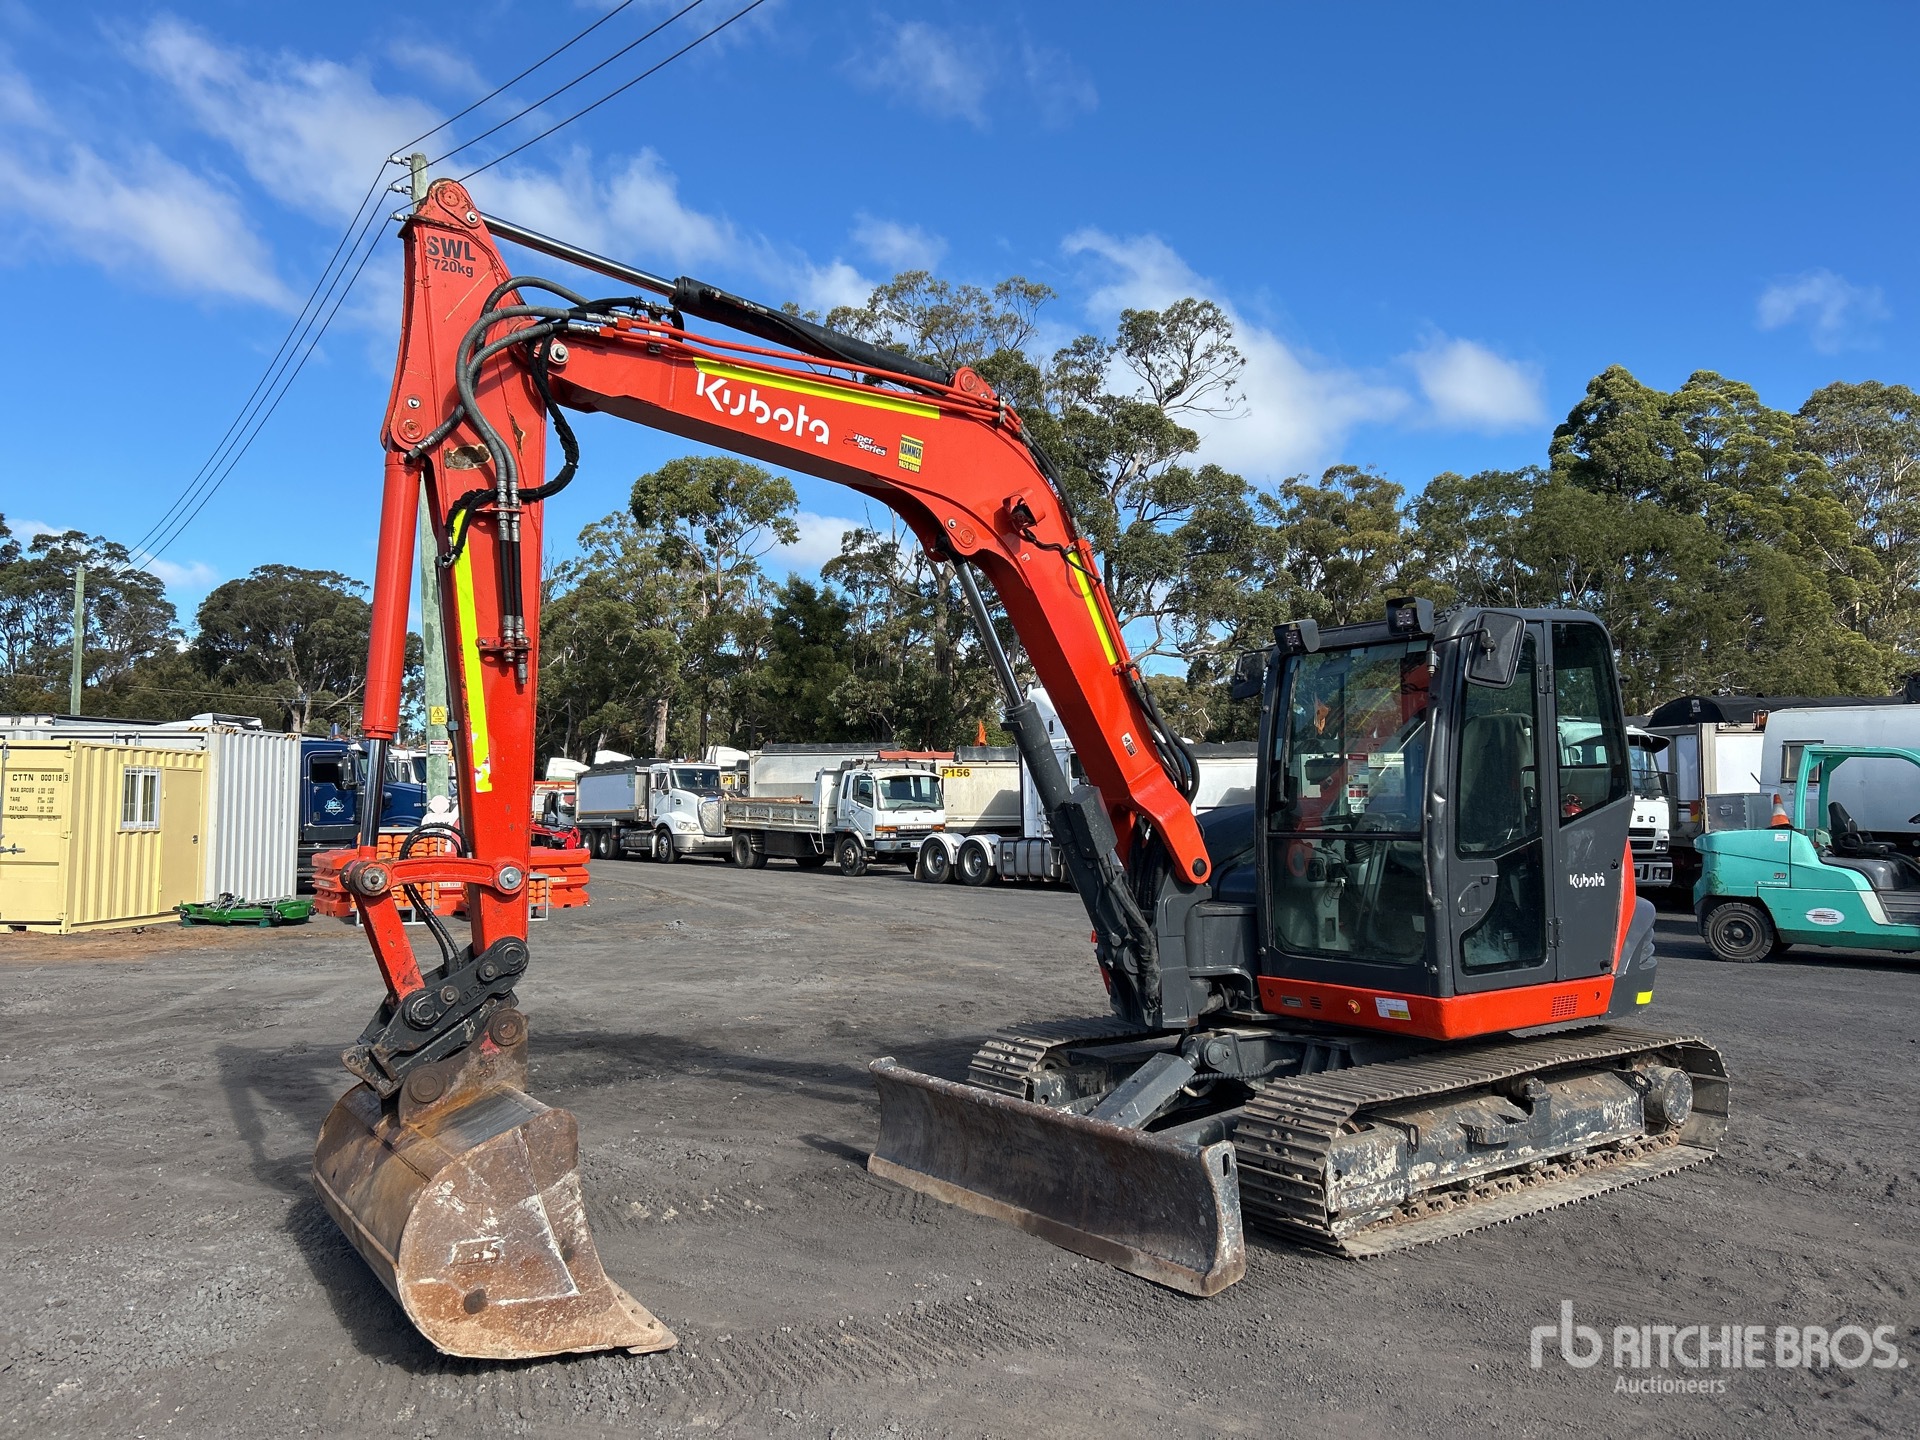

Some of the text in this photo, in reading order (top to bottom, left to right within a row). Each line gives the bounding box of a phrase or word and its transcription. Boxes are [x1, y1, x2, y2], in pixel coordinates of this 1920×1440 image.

[426, 235, 476, 261] SWL
[432, 258, 474, 278] 720kg
[695, 372, 831, 445] Kubota
[857, 440, 887, 456] Series
[12, 773, 34, 781] CTTN
[941, 768, 971, 778] P156
[1569, 872, 1605, 888] Kubota
